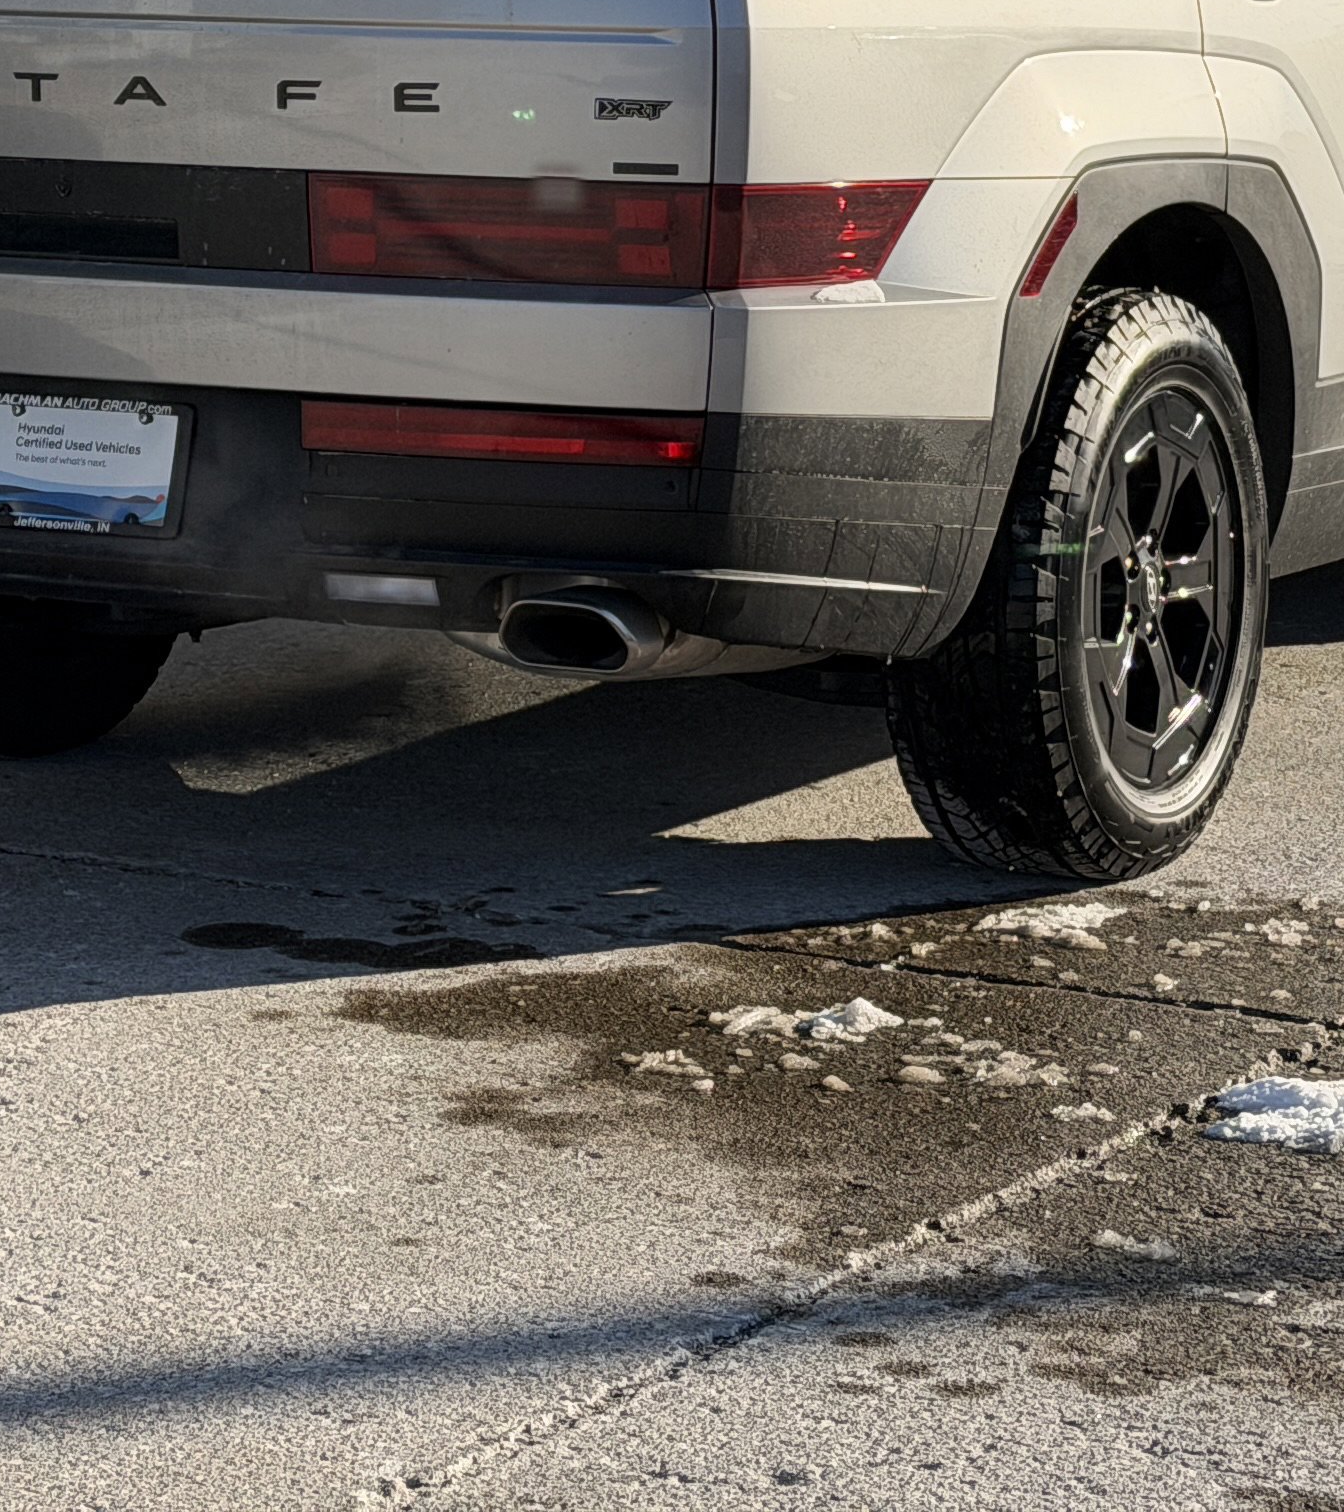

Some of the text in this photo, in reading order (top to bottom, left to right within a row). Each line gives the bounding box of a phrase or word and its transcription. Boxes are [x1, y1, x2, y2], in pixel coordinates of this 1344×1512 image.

[276, 80, 440, 113] FE
[597, 98, 672, 120] XRT
[64, 397, 99, 410] AUTO
[17, 422, 65, 436] Hyundai
[15, 436, 142, 456] Certified Used Vehicles
[15, 453, 30, 462] The
[31, 454, 48, 464] best
[49, 456, 58, 464] of
[59, 456, 87, 467] what's
[14, 516, 111, 533] Jeffersonville, IN
